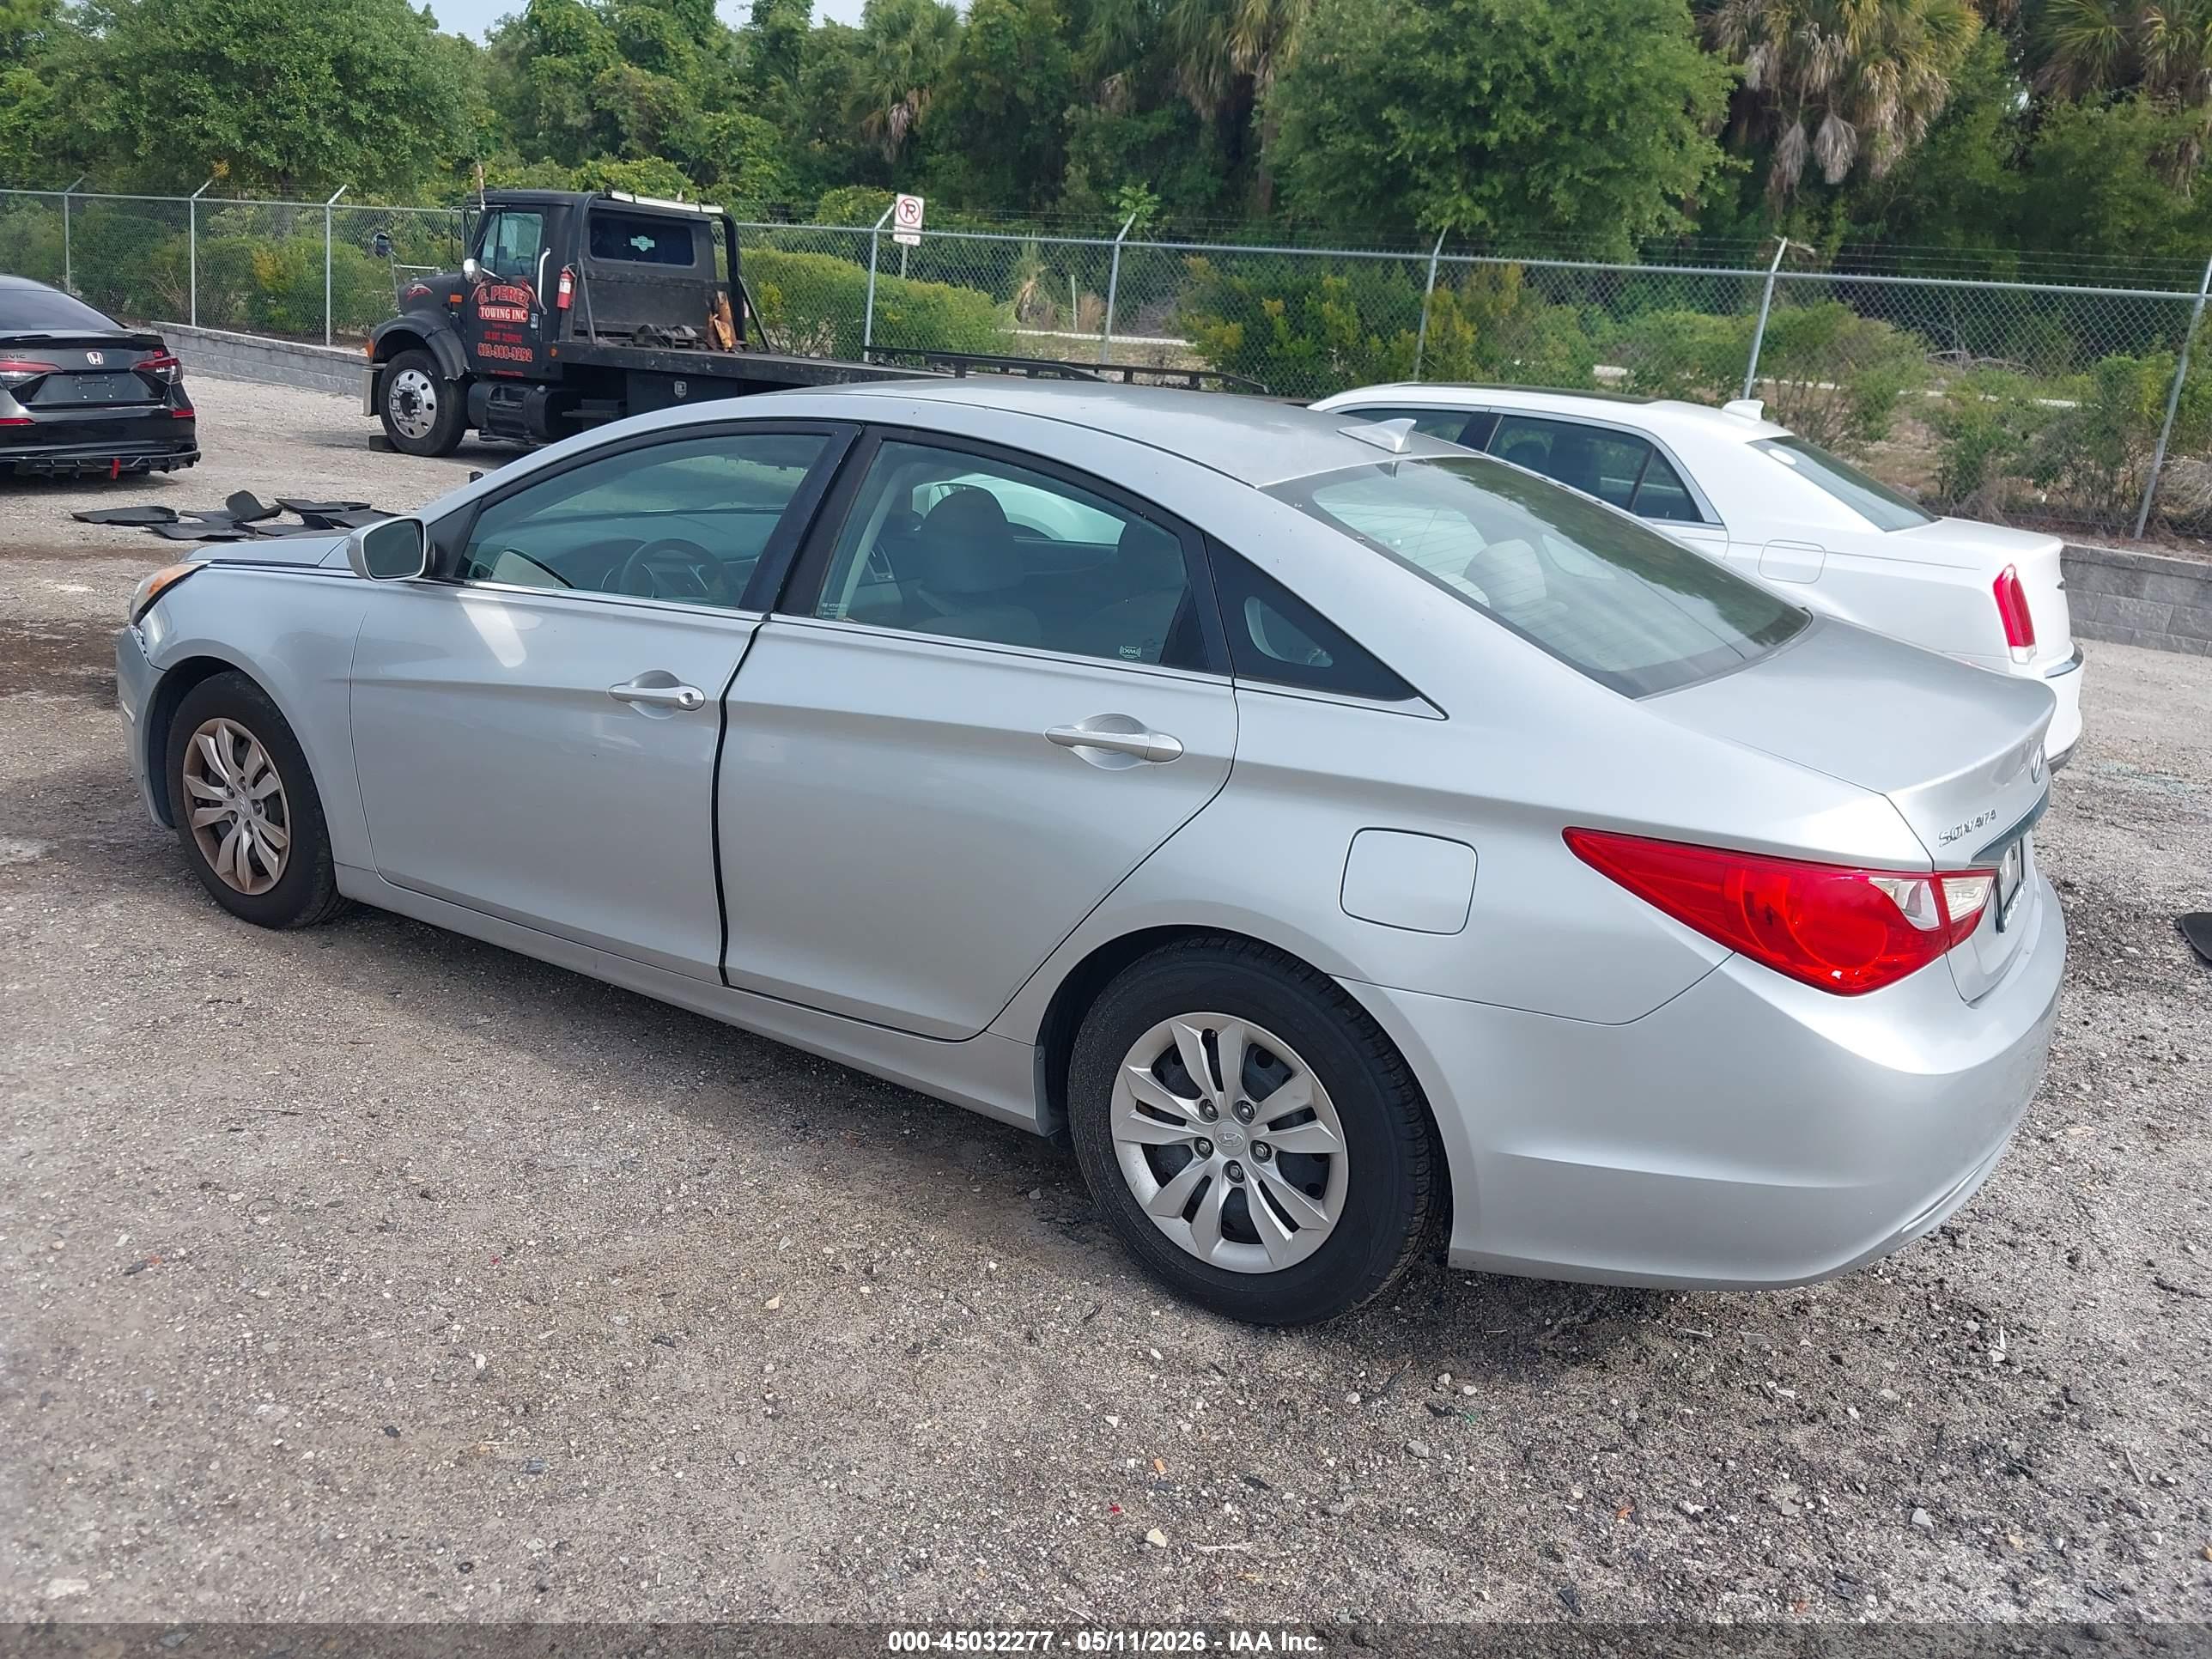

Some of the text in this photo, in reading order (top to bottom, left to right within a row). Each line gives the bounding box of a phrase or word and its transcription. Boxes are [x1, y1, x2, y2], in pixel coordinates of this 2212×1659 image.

[491, 286, 529, 308] PEREZ
[481, 307, 526, 320] TOWING INC
[1938, 808, 1997, 848] SONATA
